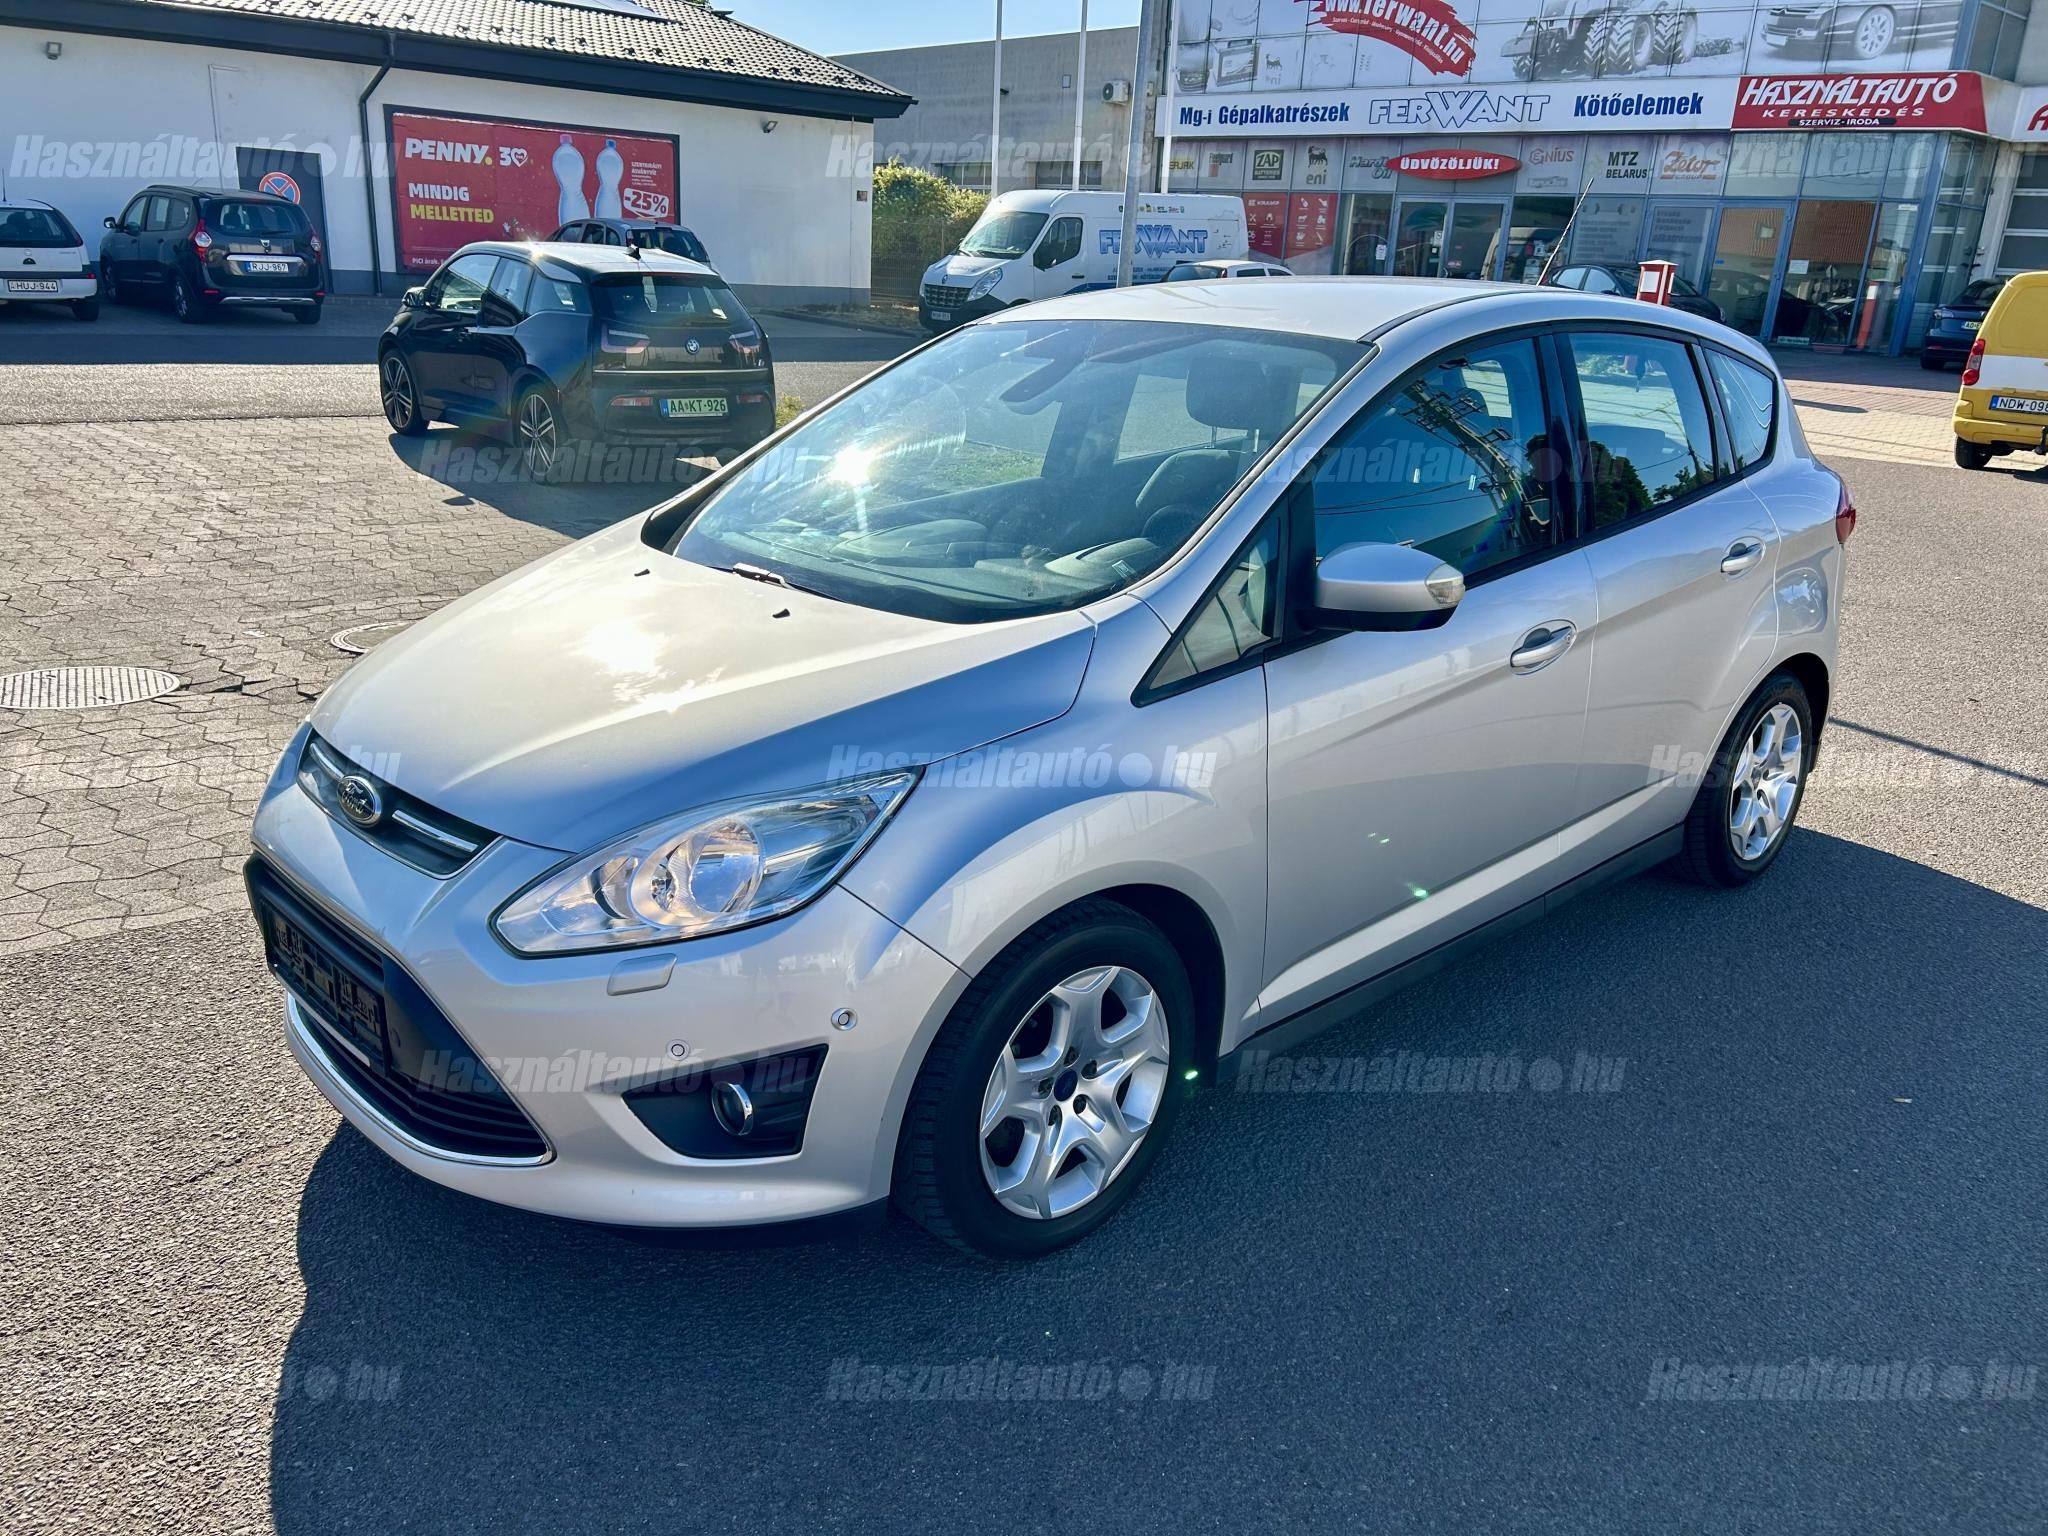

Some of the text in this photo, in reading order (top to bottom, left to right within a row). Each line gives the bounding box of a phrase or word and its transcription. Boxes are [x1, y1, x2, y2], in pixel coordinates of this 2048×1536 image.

[1739, 73, 1959, 106] HASZNÁLTAUTÓ
[1368, 90, 1551, 128] FERWANT
[1573, 92, 1704, 117] Kötőelemek
[1762, 106, 1925, 118] KERESKEDÉS
[1179, 102, 1351, 127] Mg-i Gépalkatrészek
[1256, 153, 1279, 167] ZAP
[1400, 157, 1500, 170] ÜDVÖZÖLJÜK!
[1607, 151, 1639, 167] MTZ
[1663, 150, 1721, 173] Zetor
[1305, 169, 1328, 185] eni
[1605, 168, 1648, 179] BELARUS
[408, 182, 470, 201] MINDIG
[624, 190, 667, 214] -25%
[410, 203, 495, 223] MELLETTED
